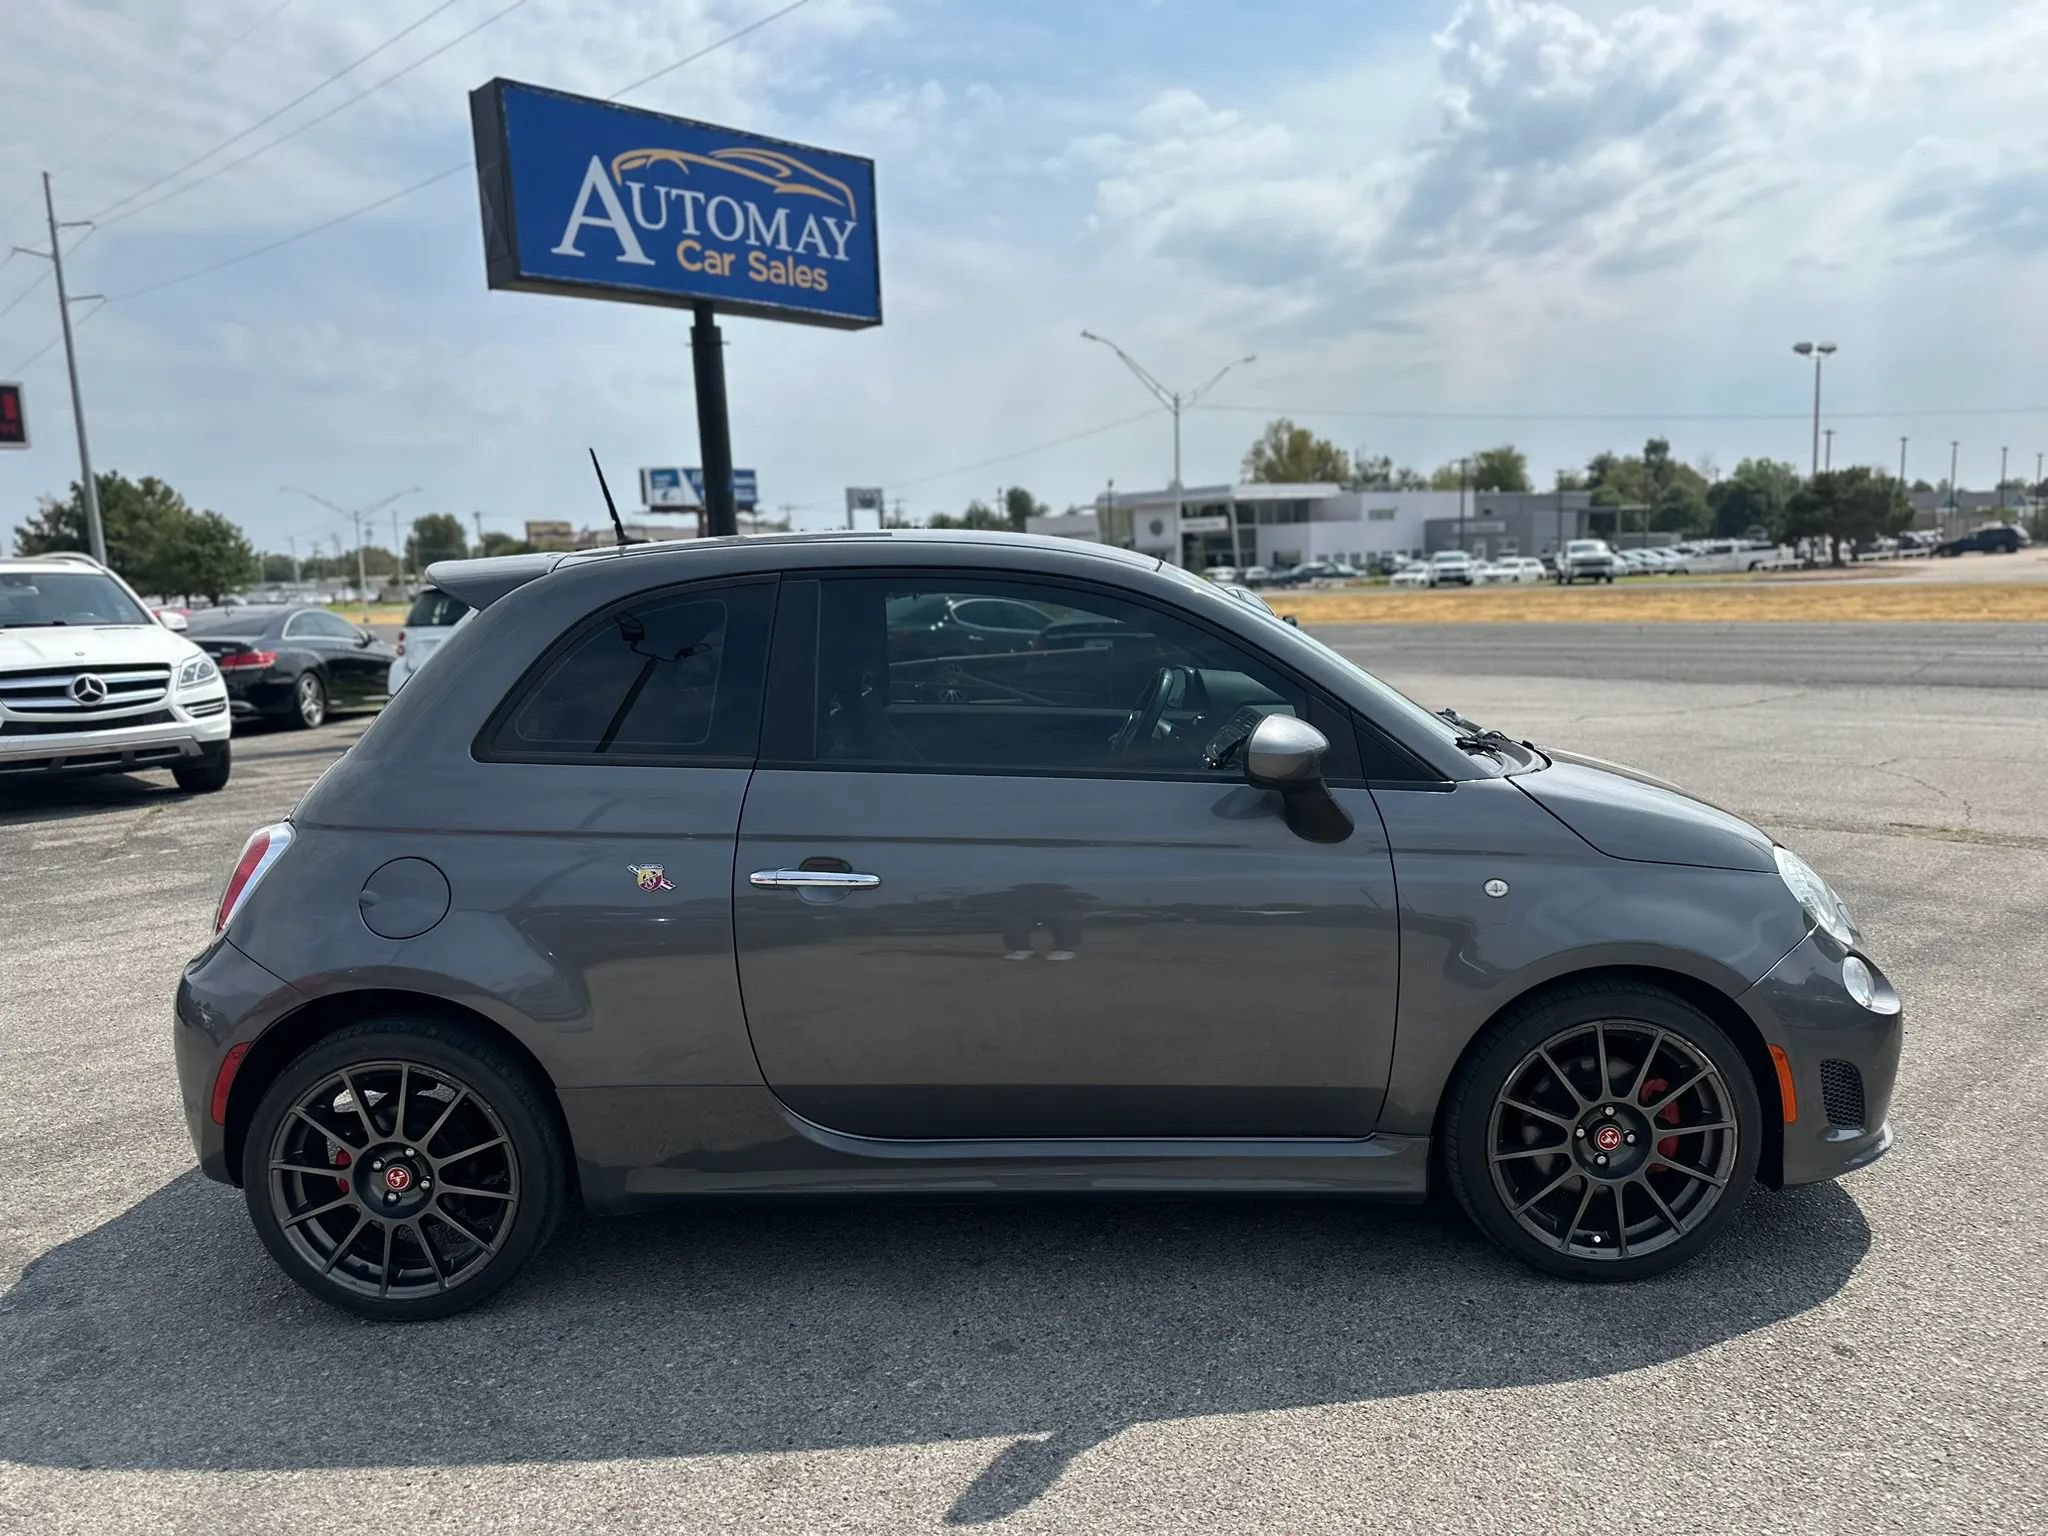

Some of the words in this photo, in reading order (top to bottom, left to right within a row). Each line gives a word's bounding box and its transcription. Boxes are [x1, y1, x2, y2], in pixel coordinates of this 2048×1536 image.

[551, 154, 858, 265] AUTOMAY
[677, 240, 735, 276] Car
[749, 251, 828, 292] Sales
